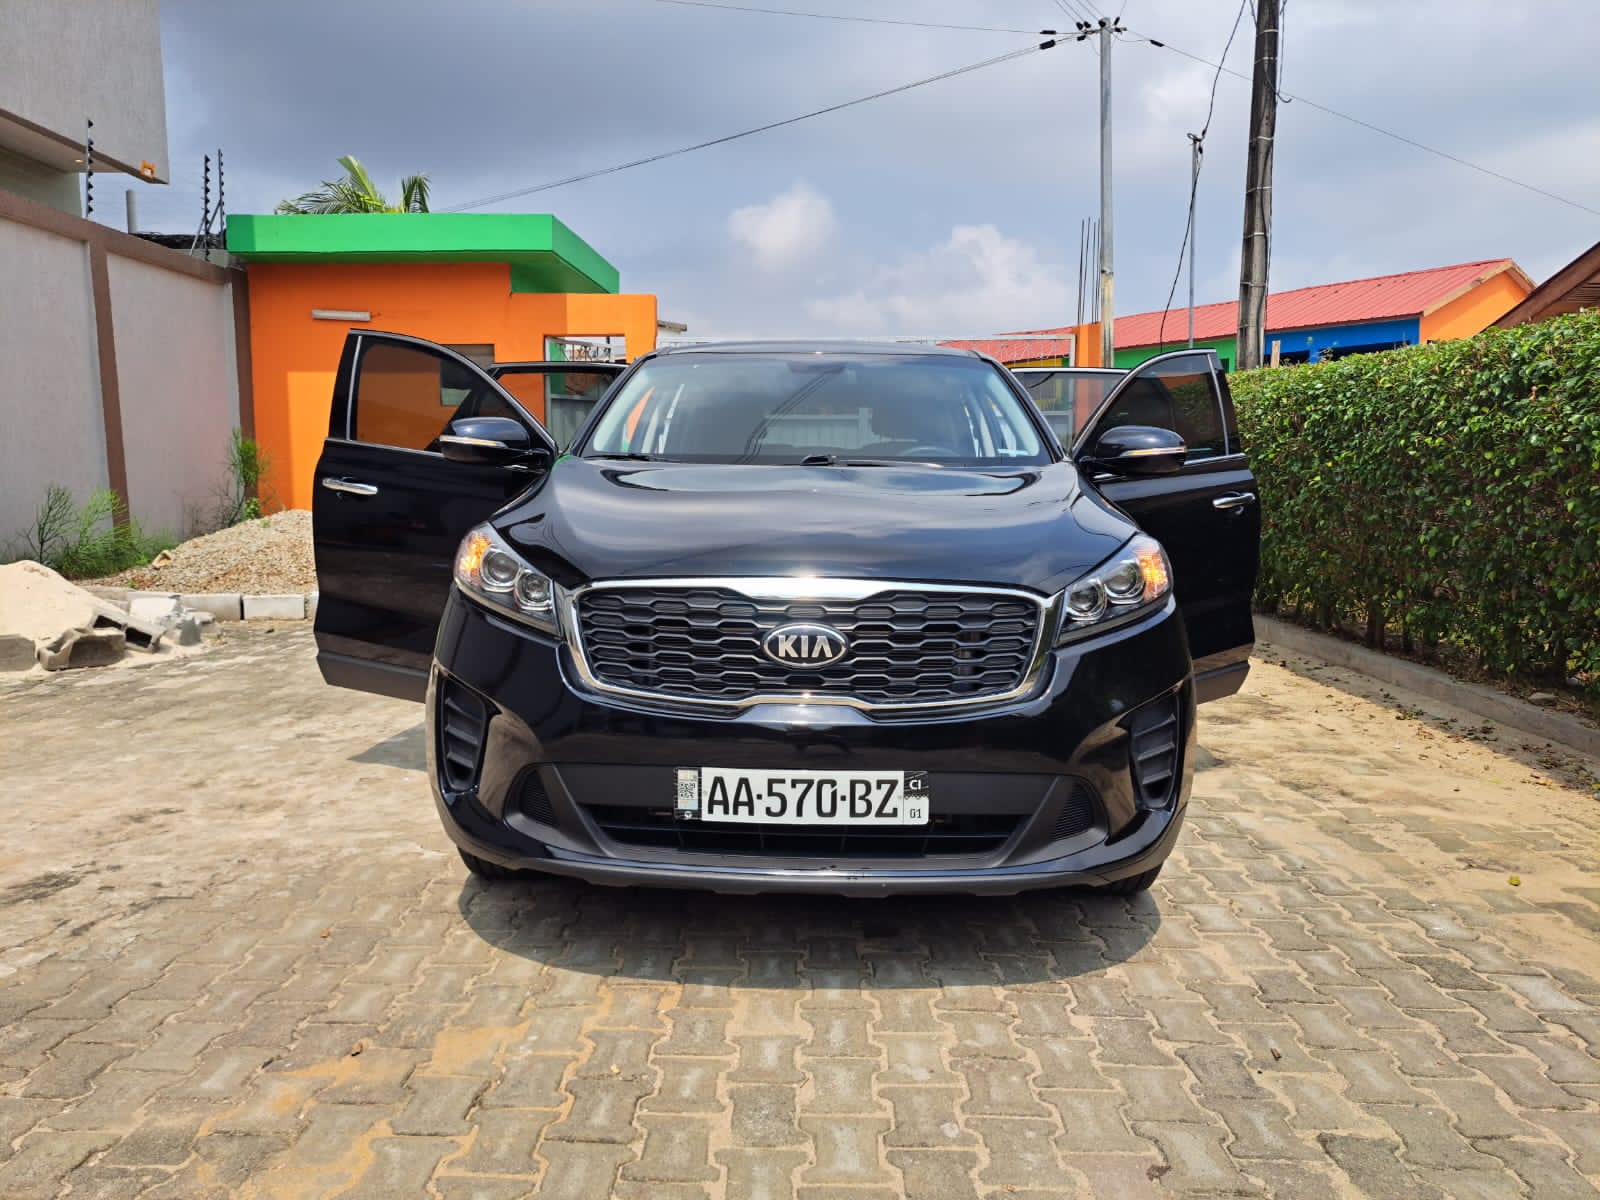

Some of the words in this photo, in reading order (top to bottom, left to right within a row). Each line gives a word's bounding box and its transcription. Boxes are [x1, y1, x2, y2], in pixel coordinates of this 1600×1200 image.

[778, 634, 833, 658] KIA
[909, 779, 922, 790] CI
[910, 808, 921, 819] 01
